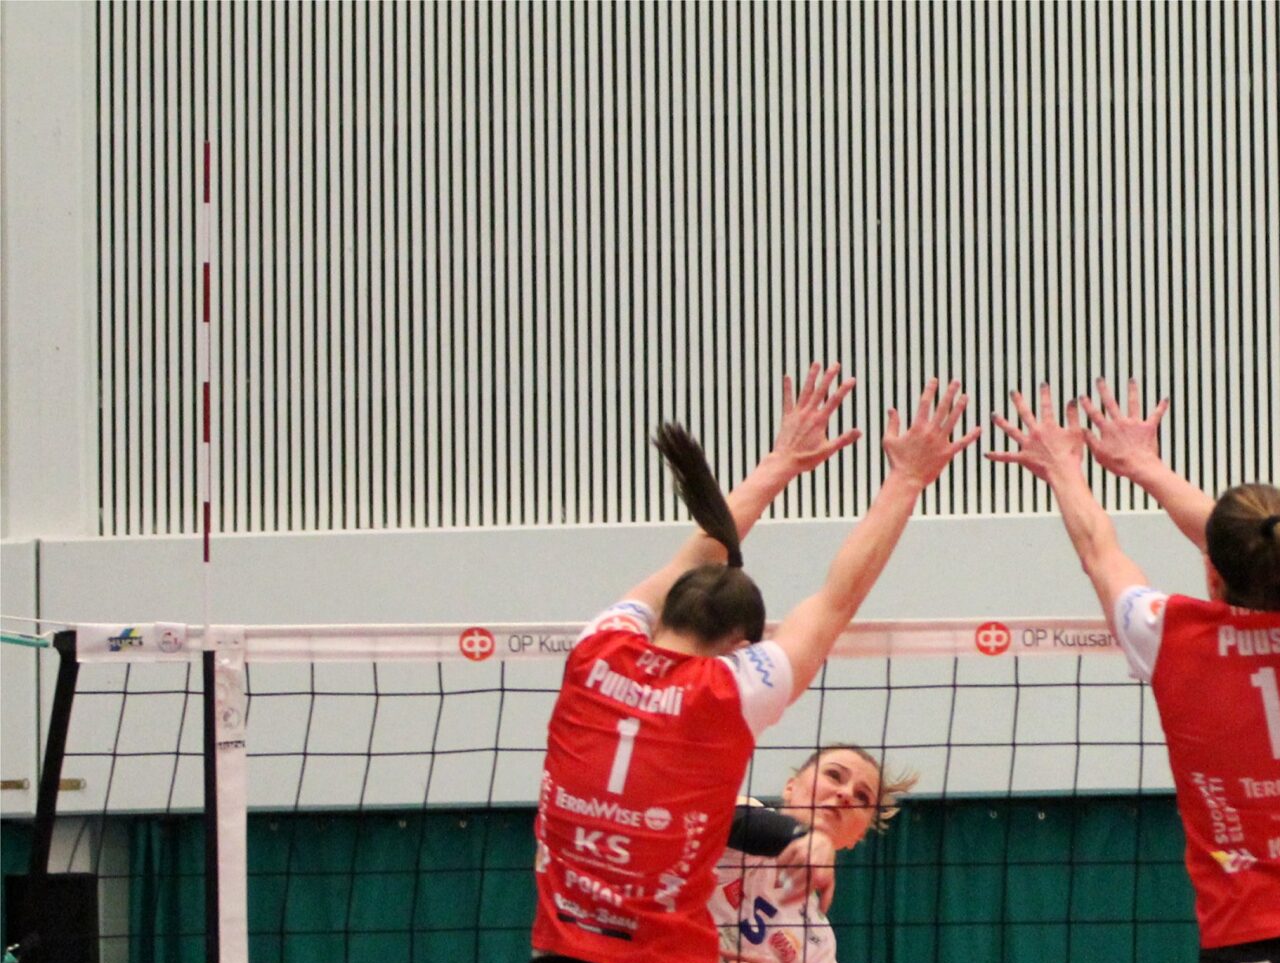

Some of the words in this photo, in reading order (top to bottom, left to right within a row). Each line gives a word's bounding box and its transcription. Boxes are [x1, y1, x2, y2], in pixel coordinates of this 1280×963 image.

[507, 634, 535, 654] OP
[538, 635, 574, 654] Kuu
[1022, 628, 1048, 648] OP
[584, 658, 685, 717] Puustelli
[606, 716, 641, 795] 1
[574, 826, 632, 864] KS
[740, 896, 778, 946] 5
